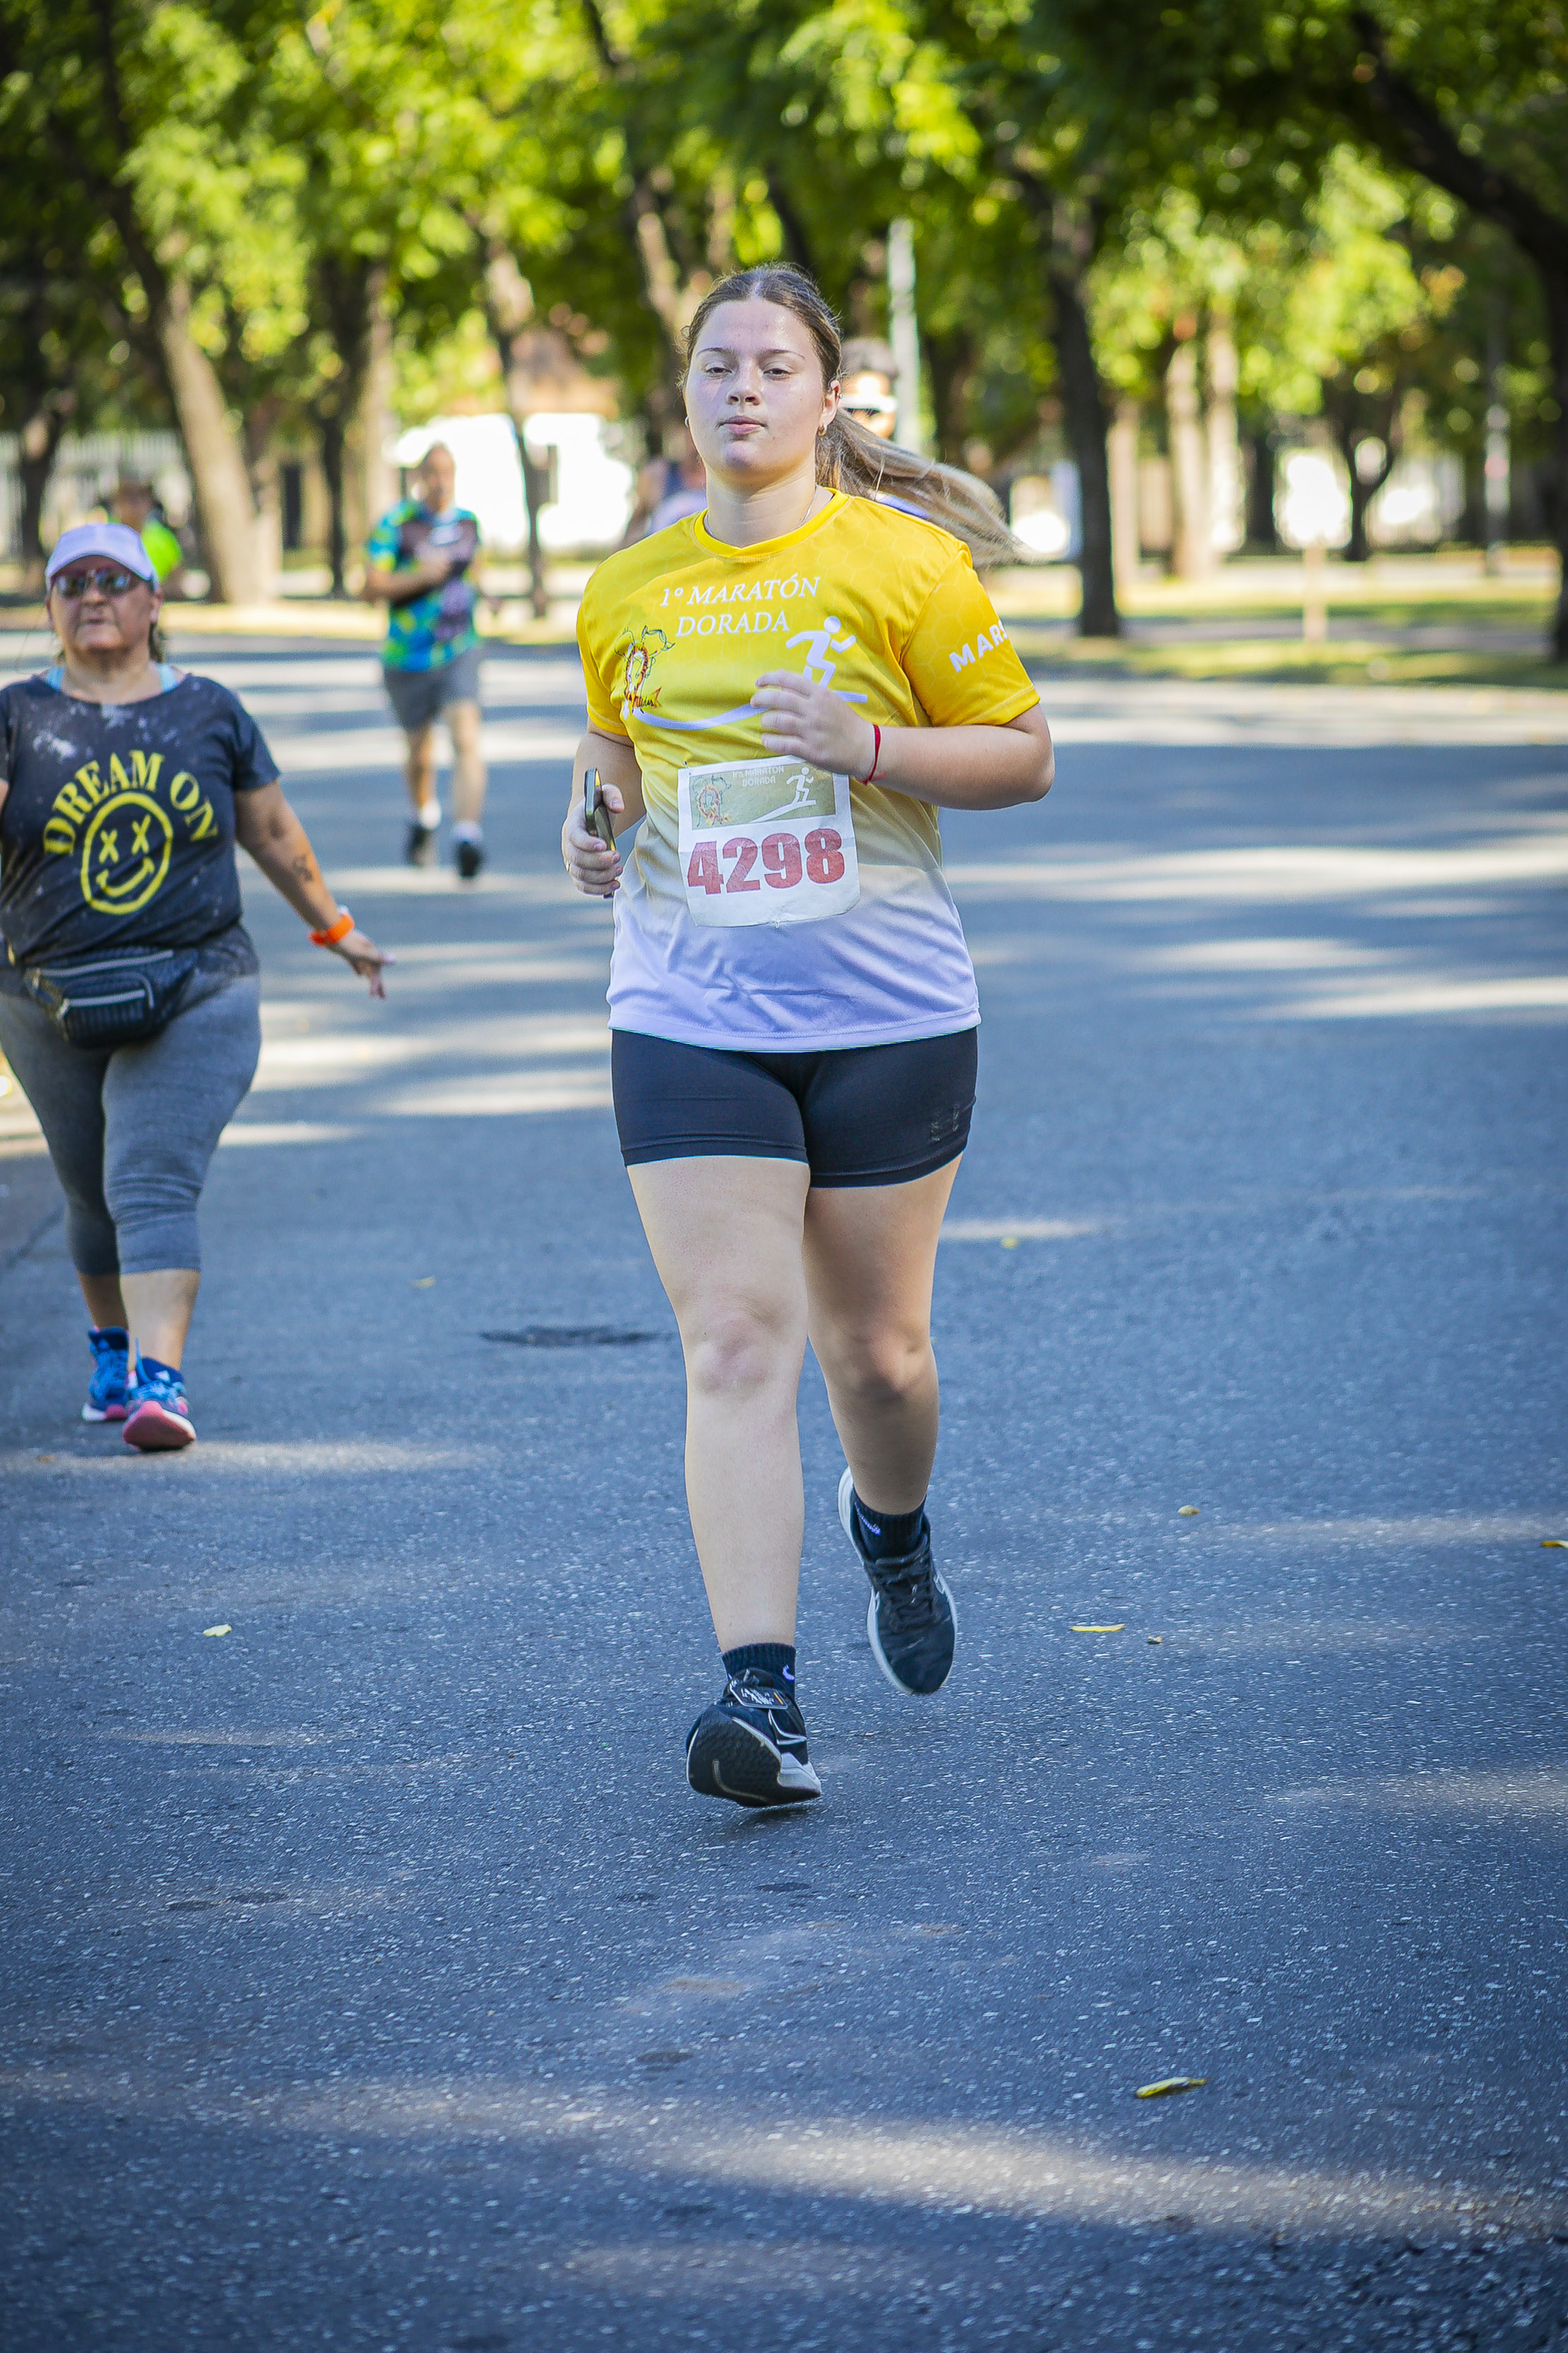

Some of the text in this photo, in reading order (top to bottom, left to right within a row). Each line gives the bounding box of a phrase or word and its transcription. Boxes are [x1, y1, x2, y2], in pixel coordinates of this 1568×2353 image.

[687, 573, 820, 605] MARATÓN
[676, 611, 789, 637] DORADA
[742, 775, 776, 787] DORADA
[43, 749, 219, 855] DREAM ON
[688, 828, 845, 895] 4298
